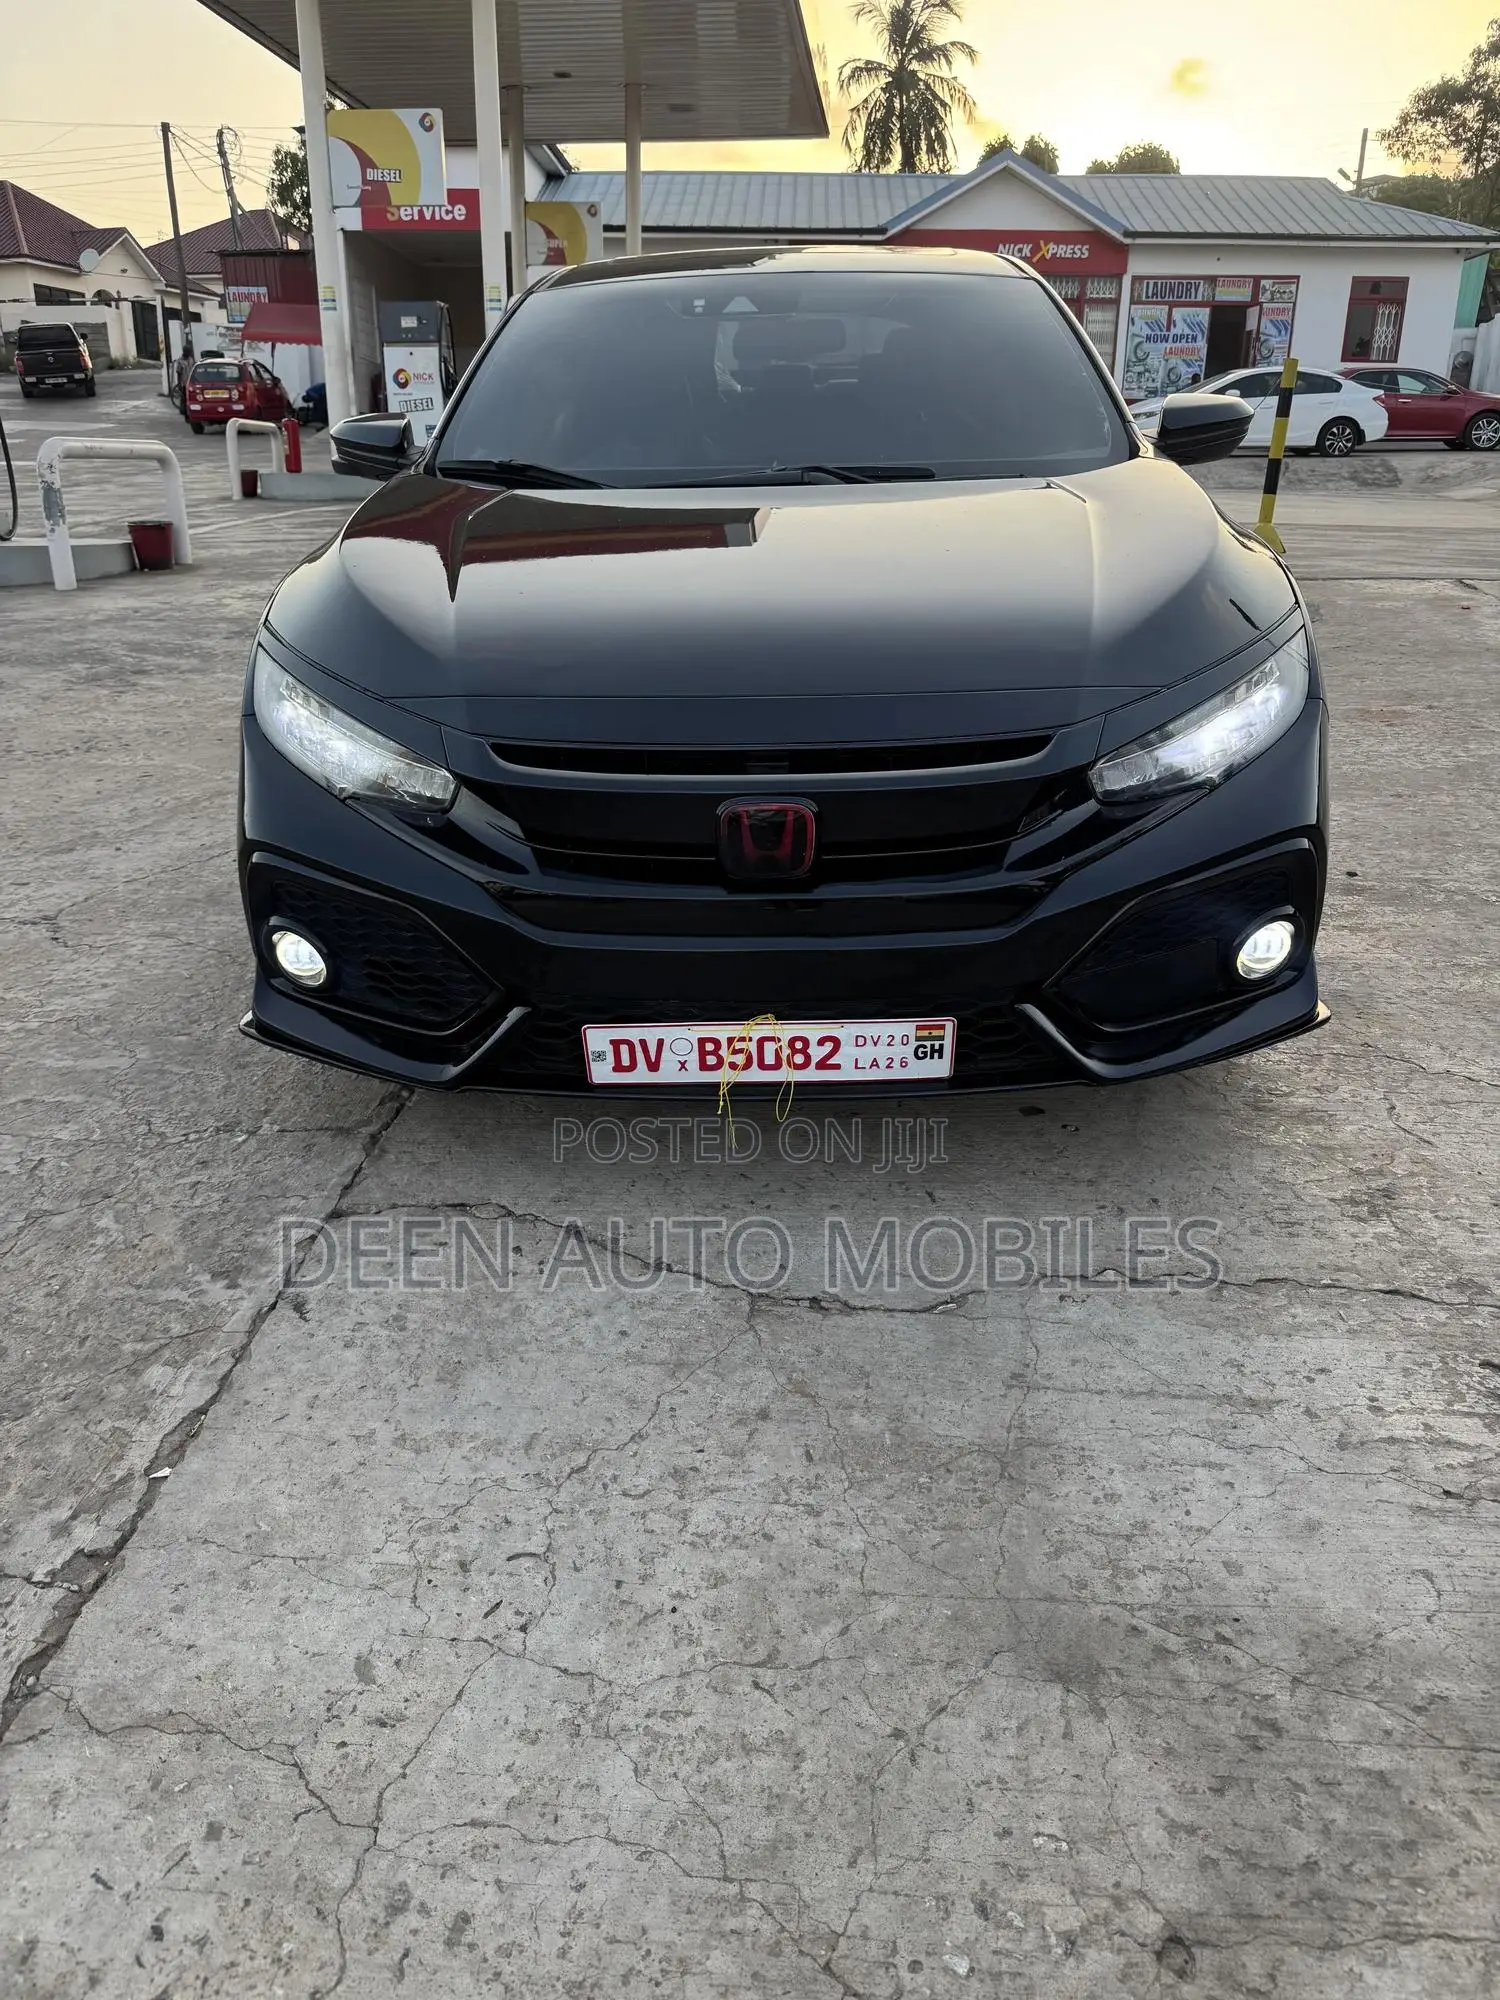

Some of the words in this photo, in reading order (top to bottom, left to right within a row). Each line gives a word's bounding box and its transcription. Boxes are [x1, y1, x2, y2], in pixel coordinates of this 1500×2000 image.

[366, 168, 401, 182] DIESEL
[386, 204, 467, 221] Service
[997, 243, 1033, 258] NICK
[1031, 240, 1090, 263] XPRESS
[1144, 281, 1201, 300] LAUNDRY
[1217, 278, 1252, 289] LAUNDRY
[228, 290, 269, 304] LAUNDRY
[1145, 333, 1170, 344] NOW
[1171, 333, 1198, 344] OPEN
[1163, 345, 1200, 359] LAUNDRY
[412, 372, 434, 381] NICK
[399, 398, 434, 412] DIESEL
[609, 1037, 665, 1073] DV
[697, 1035, 842, 1072] B5082
[913, 1043, 944, 1061] GH
